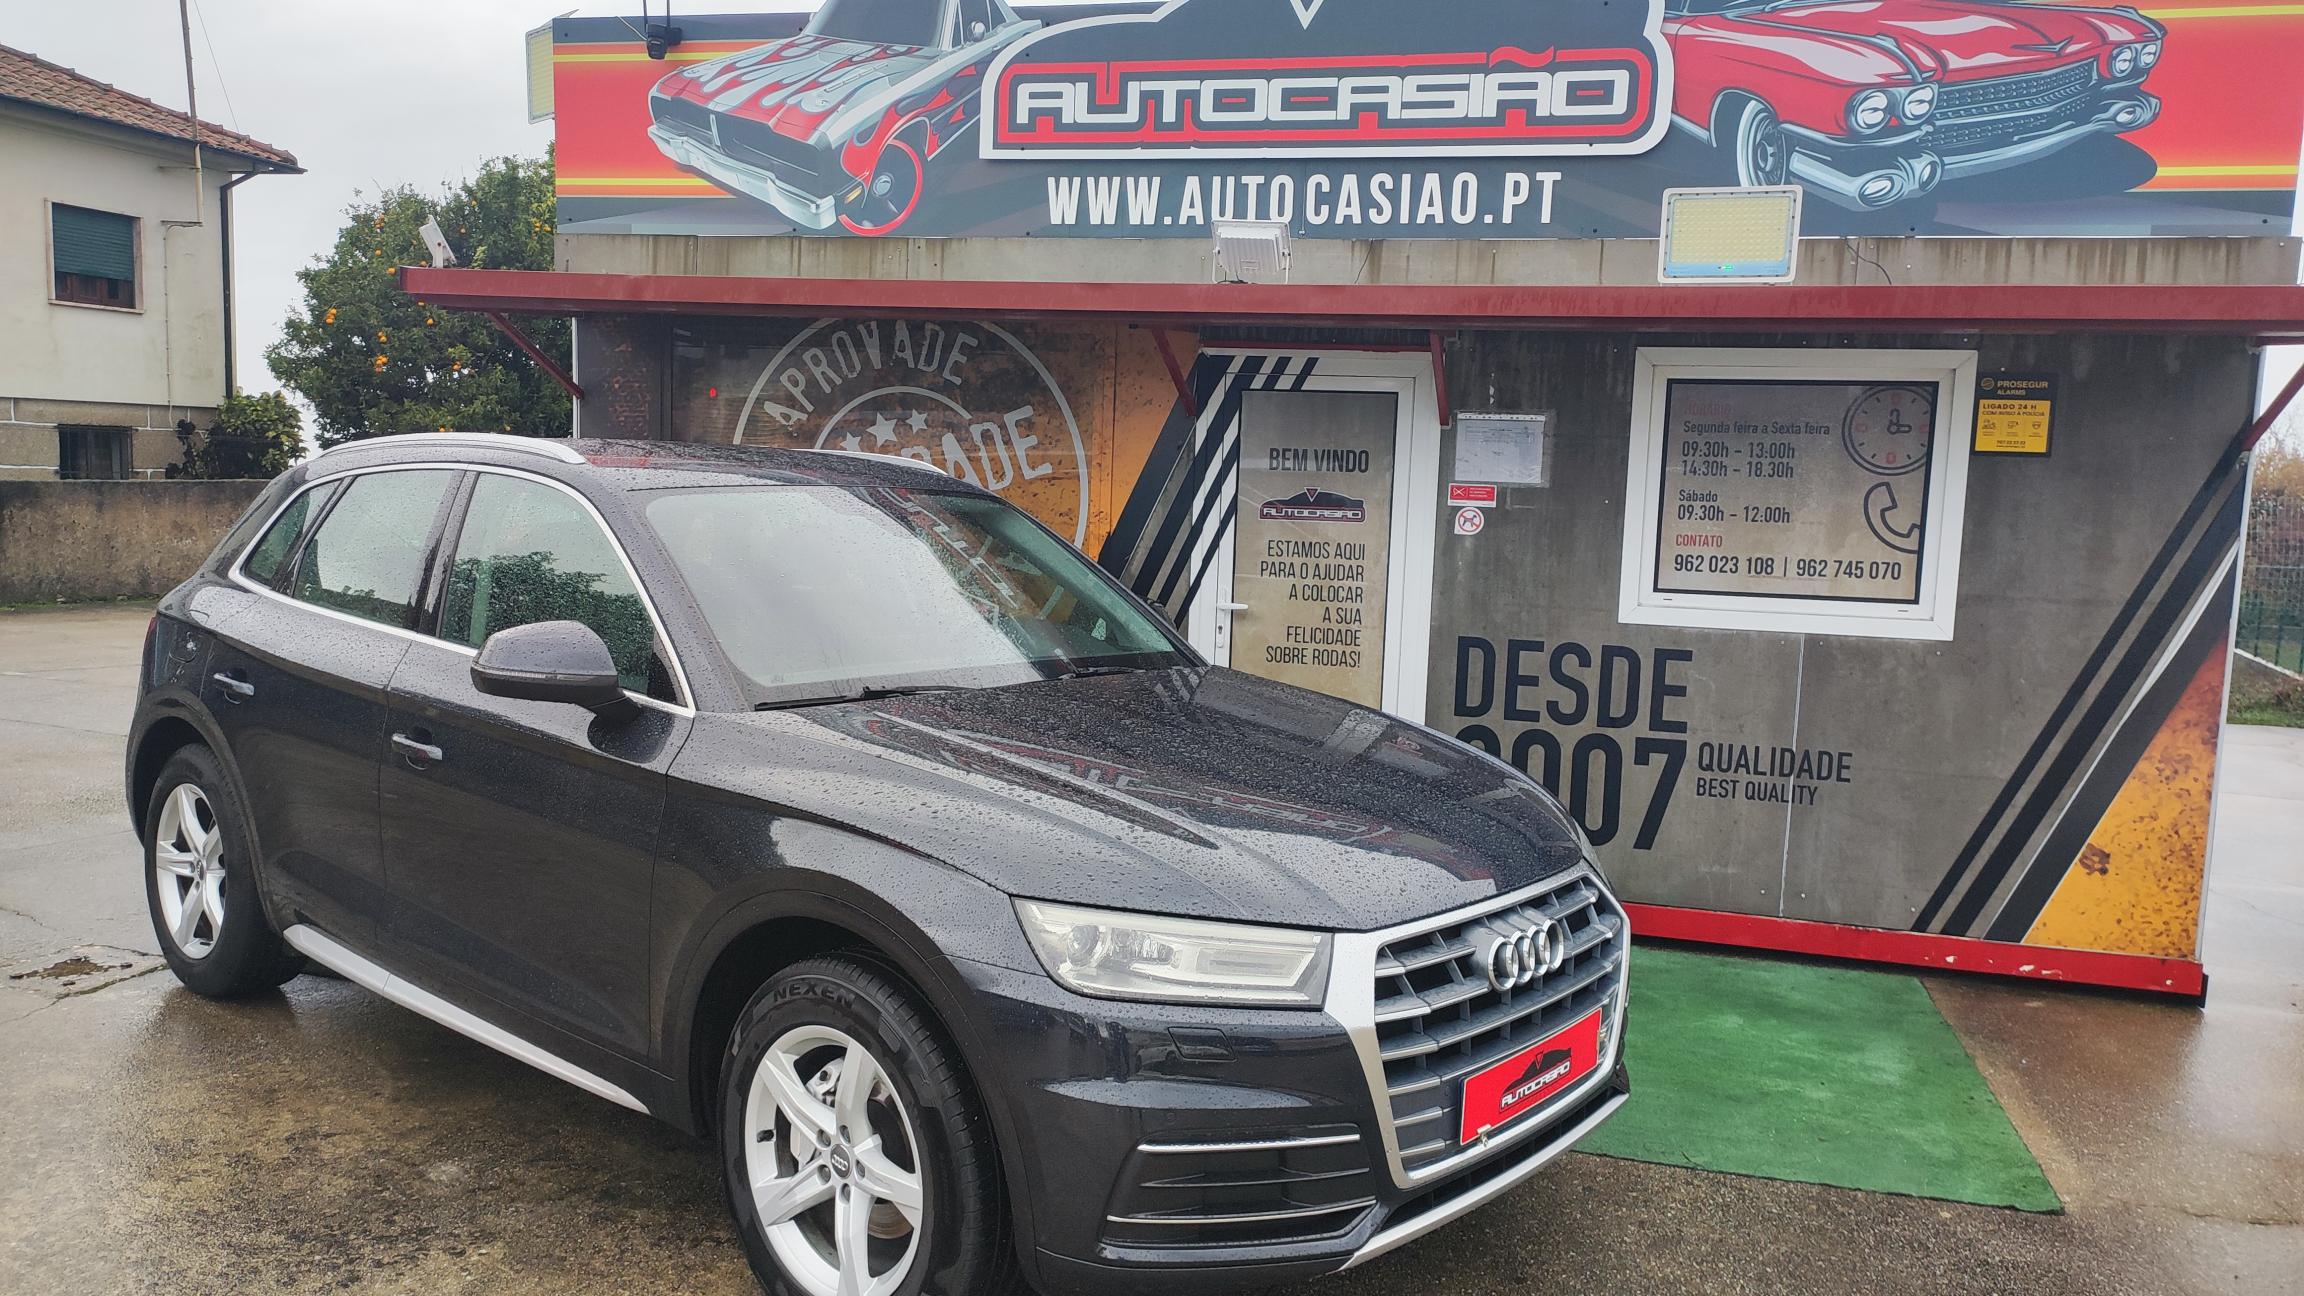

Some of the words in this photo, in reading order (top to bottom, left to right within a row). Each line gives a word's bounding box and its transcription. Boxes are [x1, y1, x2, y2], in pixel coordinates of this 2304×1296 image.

[1016, 45, 1630, 125] AUTOCASIÃO
[1047, 172, 1562, 225] WWW.AUTOCASIAO.PT
[1997, 380, 2049, 389] PROSEGUR
[1683, 420, 1730, 436] Segunda
[1733, 421, 1758, 435] feira
[1761, 424, 1768, 435] a
[1771, 421, 1800, 435] Sexta
[1804, 422, 1830, 436] feira
[1269, 447, 1308, 471] BEM
[1314, 449, 1369, 473] VINDO
[1682, 441, 1729, 459] 09:30h
[1748, 442, 1795, 460] 13:00h
[1682, 460, 1728, 478] 14:30h
[1747, 461, 1794, 479] 18.30h
[1679, 489, 1718, 503] Sábado
[1678, 505, 1724, 522] 09:30h
[1744, 506, 1790, 524] 12:00h
[1268, 540, 1330, 560] ESTAMOS
[1335, 543, 1365, 561] AQUI
[1676, 534, 1722, 549] CONTATO
[1260, 561, 1296, 579] PARA
[1300, 563, 1309, 580] O
[1313, 564, 1364, 583] AJUDAR
[1674, 554, 1704, 573] 962
[1709, 555, 1739, 574] 023
[1747, 557, 1774, 575] 108
[1796, 559, 1828, 578] 962
[1834, 560, 1864, 579] 745
[1869, 561, 1901, 580] 070
[1289, 583, 1298, 601] A
[1302, 584, 1363, 604] COLOCAR
[1322, 607, 1331, 624] A
[1336, 607, 1362, 626] SUA
[1286, 625, 1361, 647] FELICIDADE
[1266, 646, 1308, 665] SOBRE
[1313, 649, 1360, 668] RODAS!
[1454, 636, 1693, 734] DESDE
[1697, 741, 1853, 784] QUALIDADE
[1455, 724, 1688, 850] 007
[1696, 777, 1739, 799] BEST
[1744, 780, 1818, 805] QUALITY
[774, 982, 856, 1009] NEXEN
